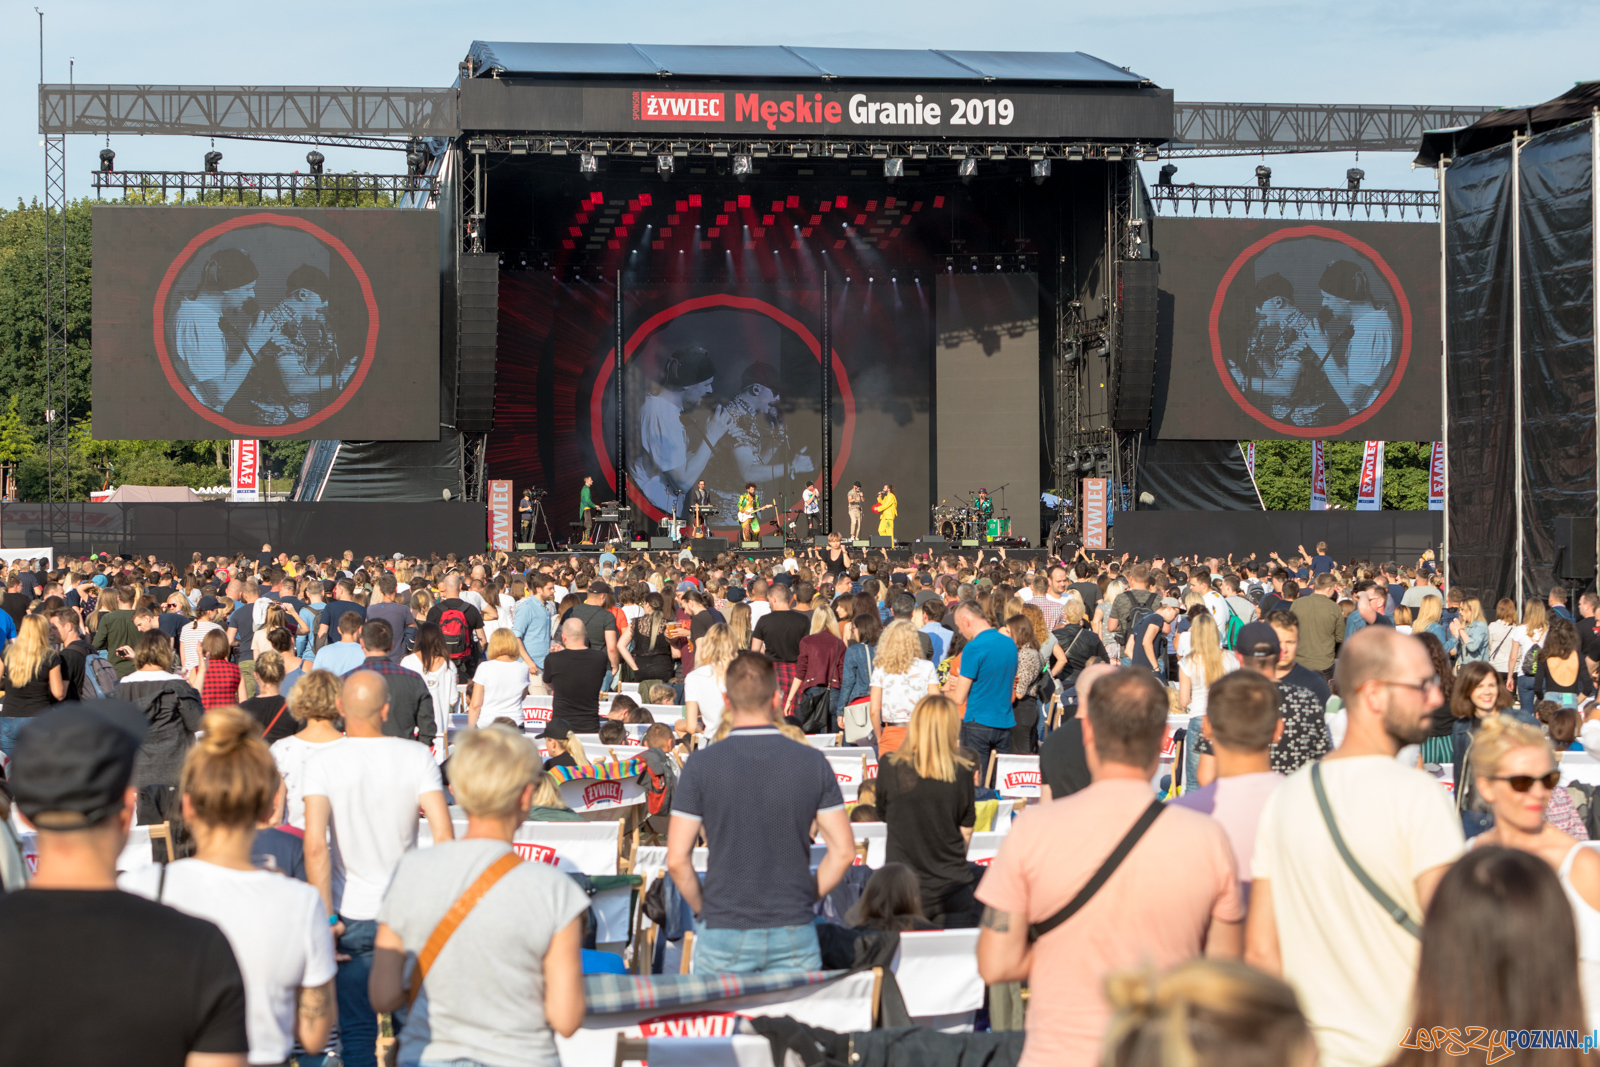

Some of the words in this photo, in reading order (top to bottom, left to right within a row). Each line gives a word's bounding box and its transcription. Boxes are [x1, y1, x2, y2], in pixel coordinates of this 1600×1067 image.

[632, 91, 640, 120] SPONSOR
[646, 95, 720, 117] ŻYWIEC
[735, 92, 842, 131] Męskie
[848, 93, 942, 126] Granie
[949, 98, 1015, 126] 2019
[490, 482, 509, 550] ŻYWIEC
[1084, 480, 1103, 547] ŻYWIEC
[588, 782, 619, 800] ŻYWIEC
